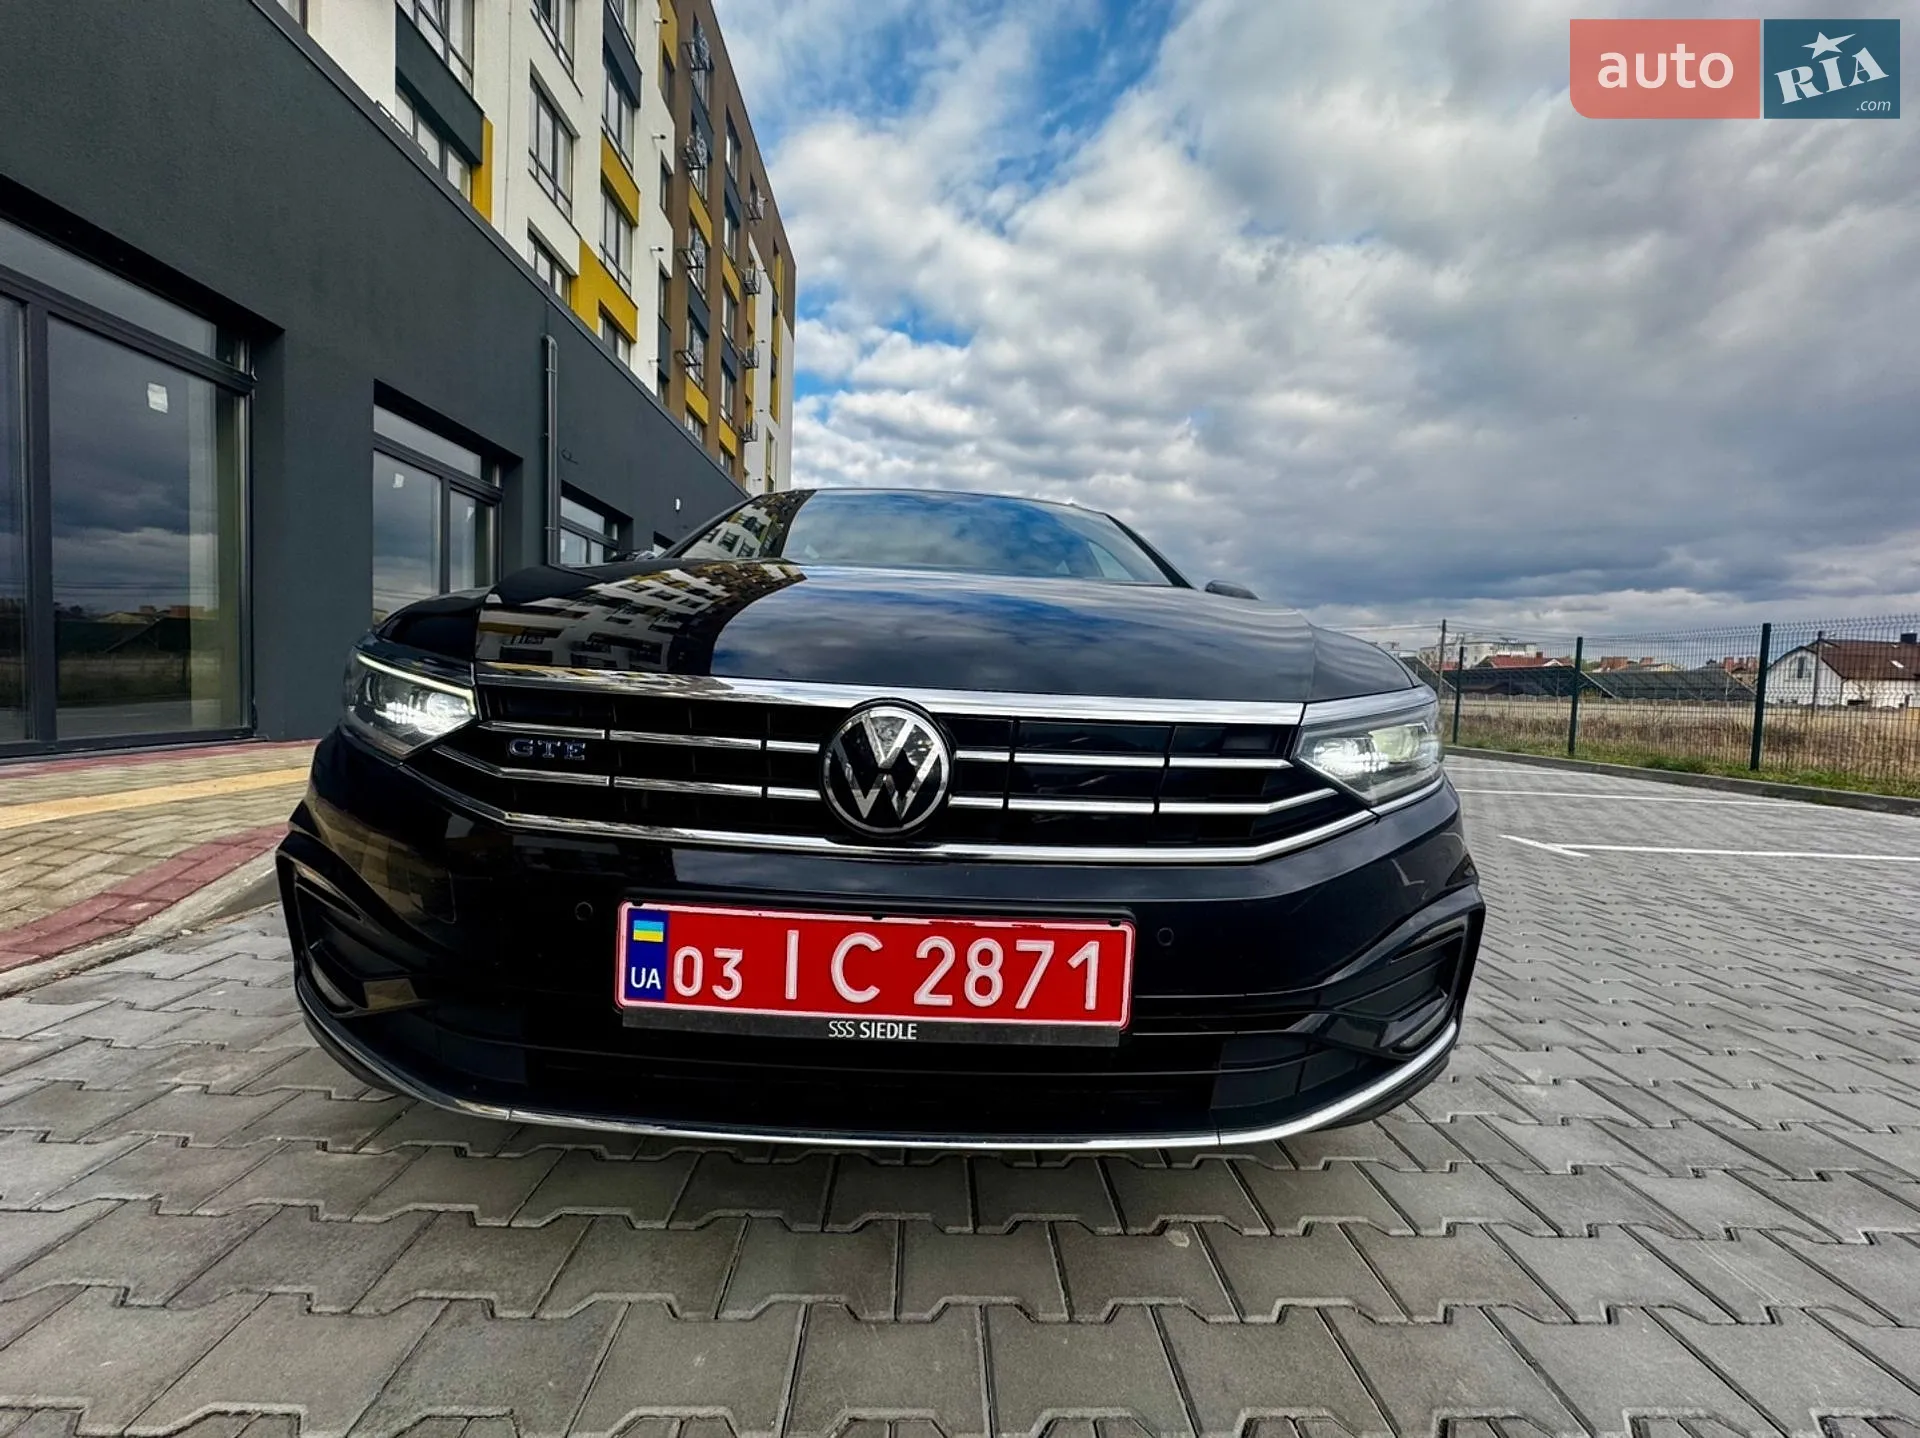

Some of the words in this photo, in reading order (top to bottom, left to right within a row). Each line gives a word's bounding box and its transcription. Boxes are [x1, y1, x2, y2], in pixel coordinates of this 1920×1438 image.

[509, 739, 586, 760] GTE
[630, 966, 662, 990] UA
[673, 945, 744, 1000] 03
[913, 936, 1100, 1011] 2871
[828, 1020, 855, 1038] SSS
[859, 1021, 917, 1040] SIEDLE
